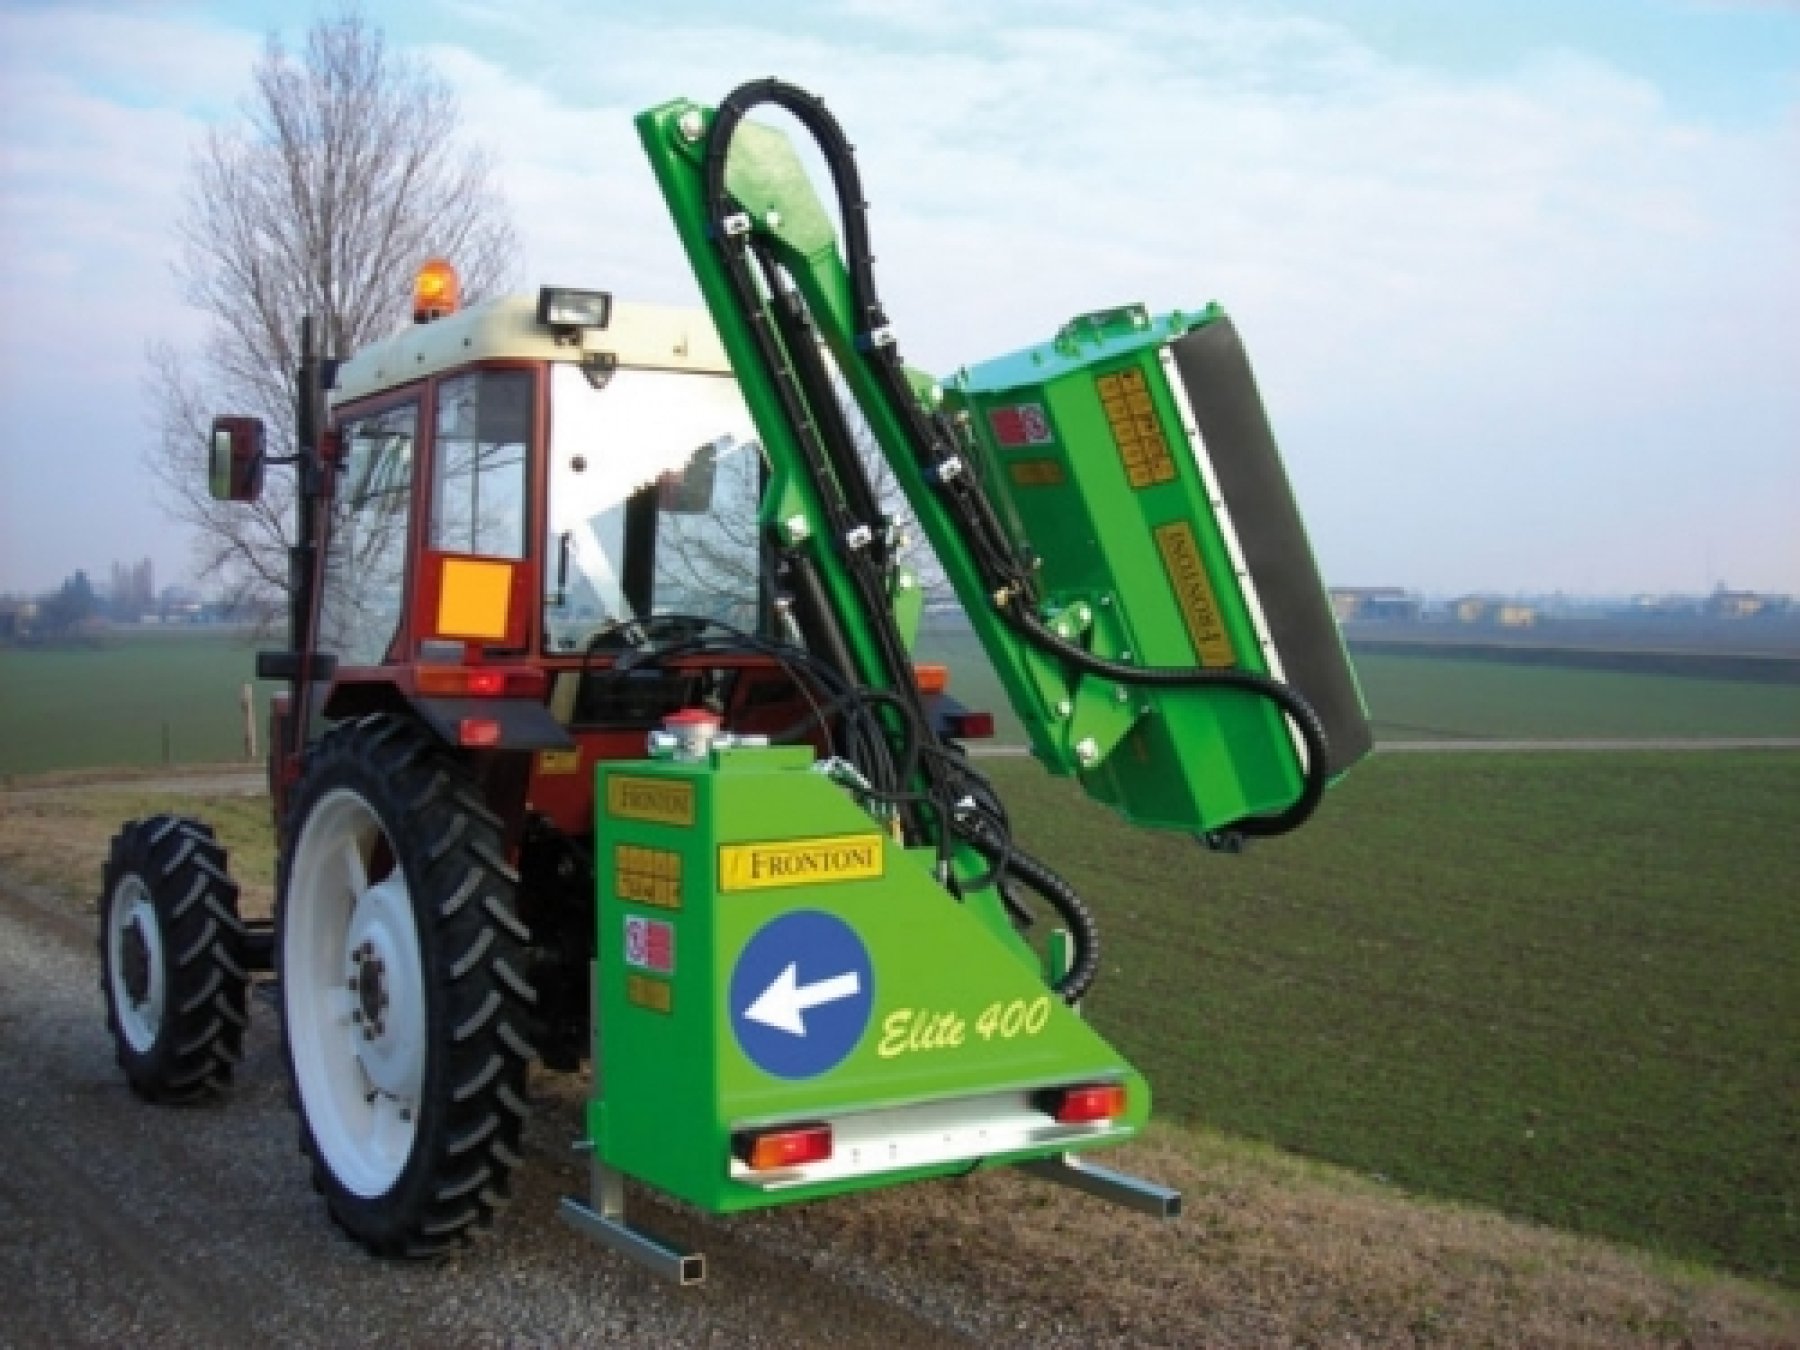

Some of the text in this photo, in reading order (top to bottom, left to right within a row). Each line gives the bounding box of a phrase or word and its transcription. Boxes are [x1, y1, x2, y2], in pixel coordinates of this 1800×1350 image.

[751, 846, 873, 879] FRONTONI
[877, 996, 1050, 1059] Elite 400
